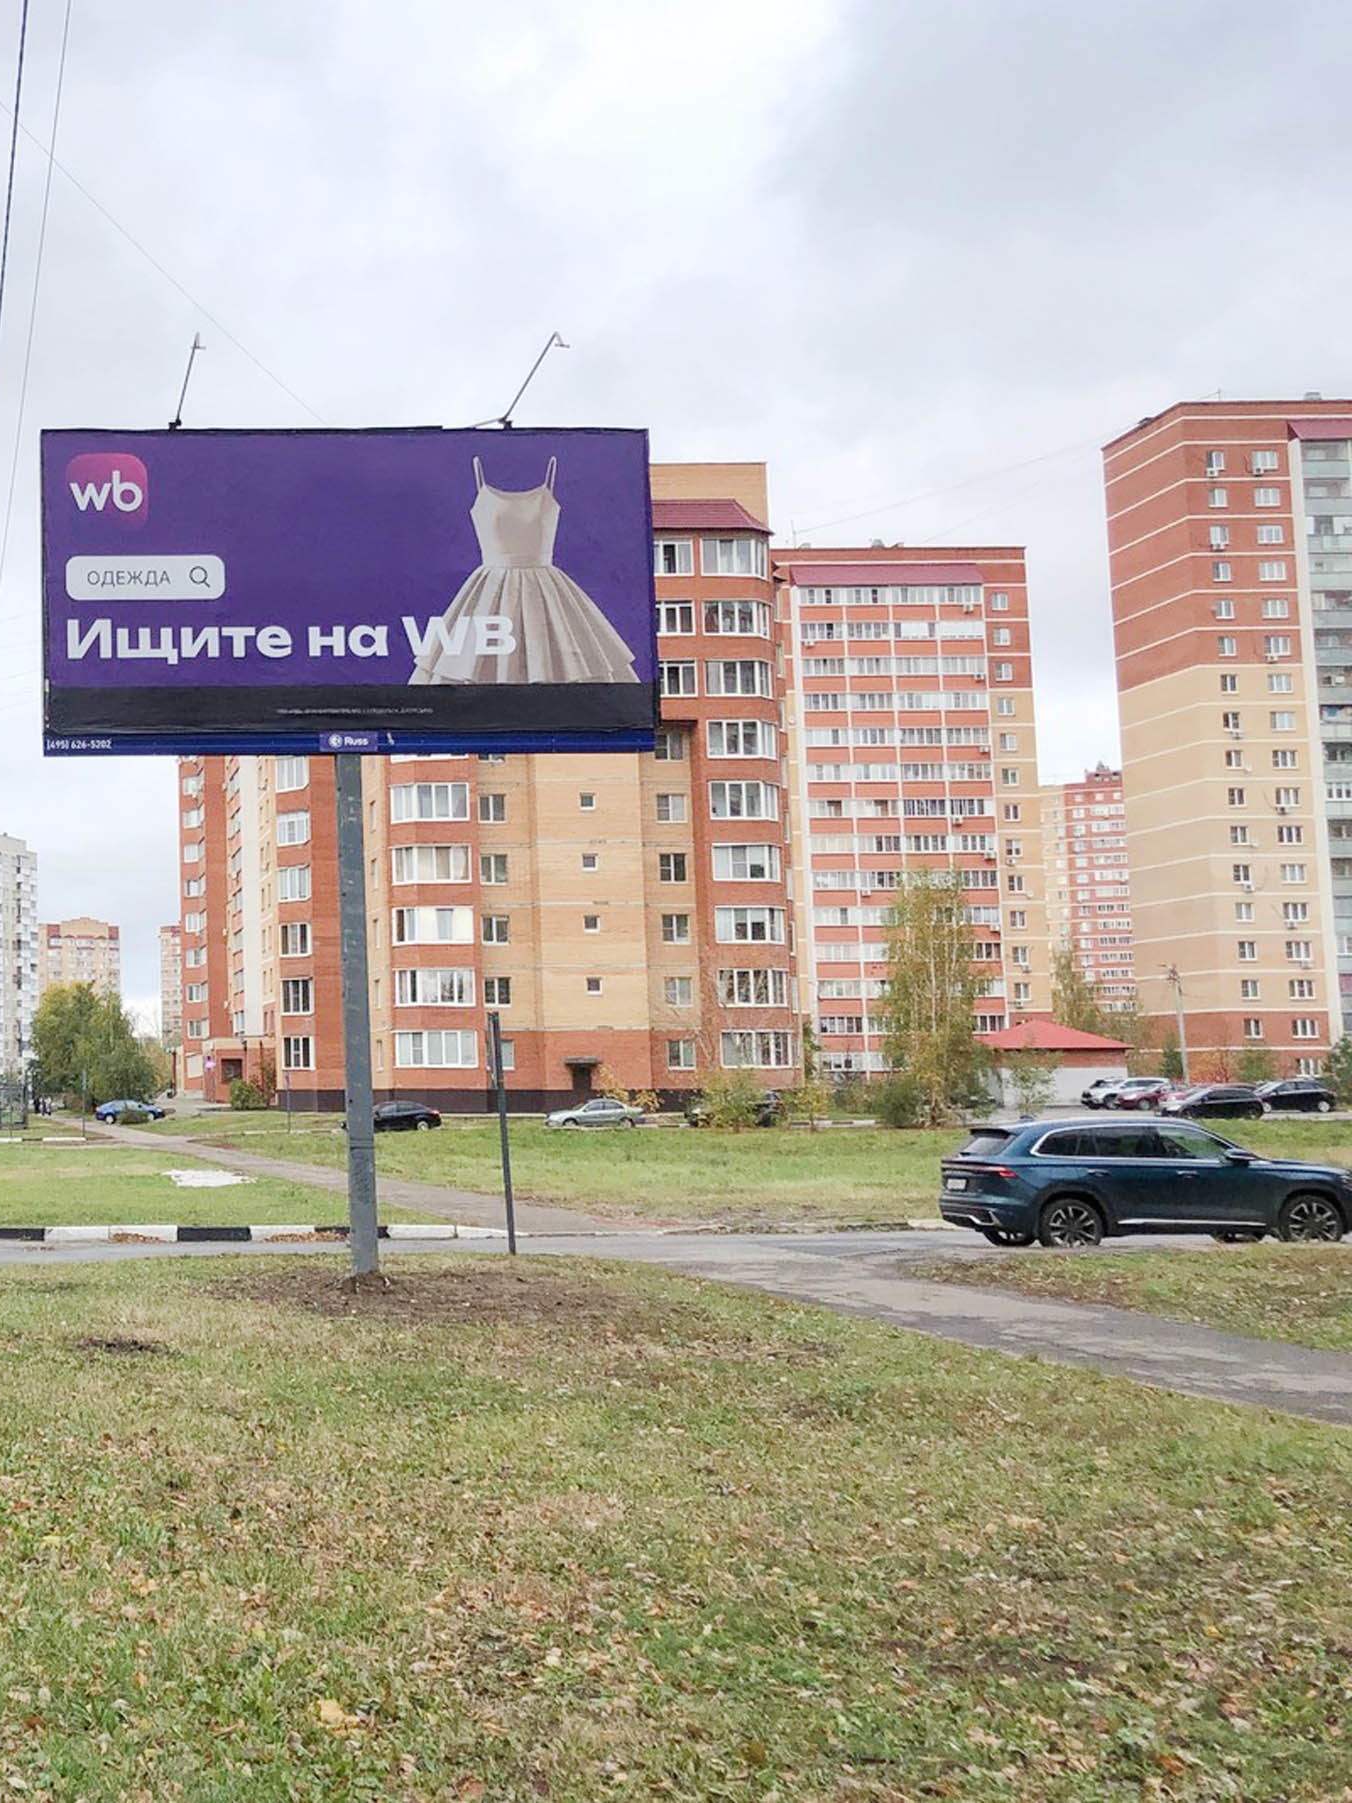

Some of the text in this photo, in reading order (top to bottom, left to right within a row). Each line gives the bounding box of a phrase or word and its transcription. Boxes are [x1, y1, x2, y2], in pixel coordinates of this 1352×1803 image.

[69, 469, 143, 512] wb
[87, 570, 171, 587] ОДЕЖДА
[66, 615, 517, 665] Ищите на WB
[343, 736, 369, 747] Russ
